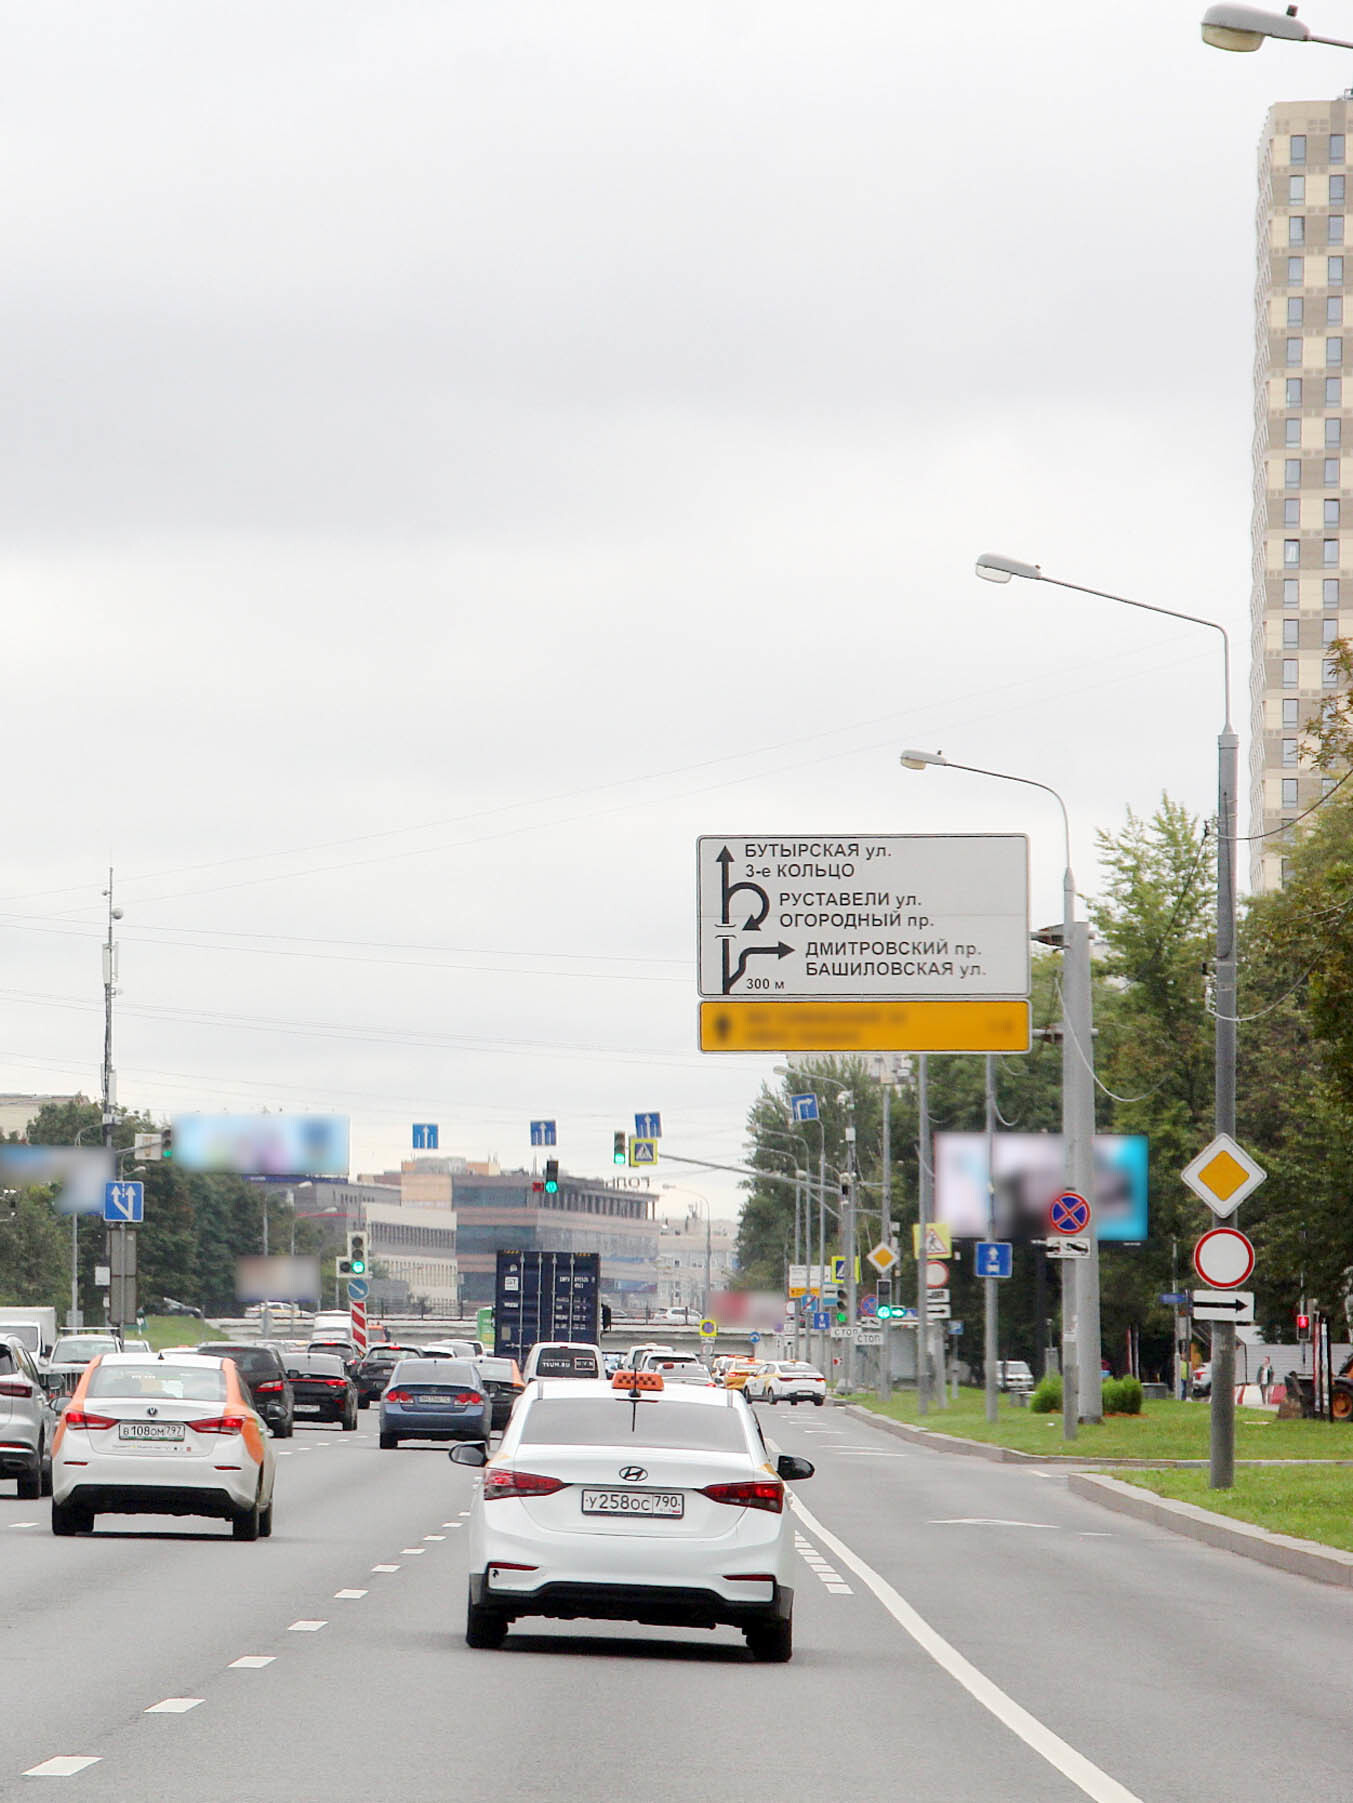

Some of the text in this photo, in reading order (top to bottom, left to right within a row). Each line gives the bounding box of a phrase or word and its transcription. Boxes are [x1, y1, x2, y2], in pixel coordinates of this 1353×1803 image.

[745, 844, 892, 860] БУТЫРСКАЯ ул.
[746, 863, 855, 879] 3-е КОЛЬЦО
[779, 892, 922, 909] РУСТАВЕЛИ ул.
[779, 911, 934, 930] ОГОРОДНЫЙ пр.
[805, 939, 982, 959] ДМИТРОВСКИЙ пр.
[806, 962, 986, 979] БАШИЛОВСКАЯ ул.
[746, 978, 785, 990] 300 м
